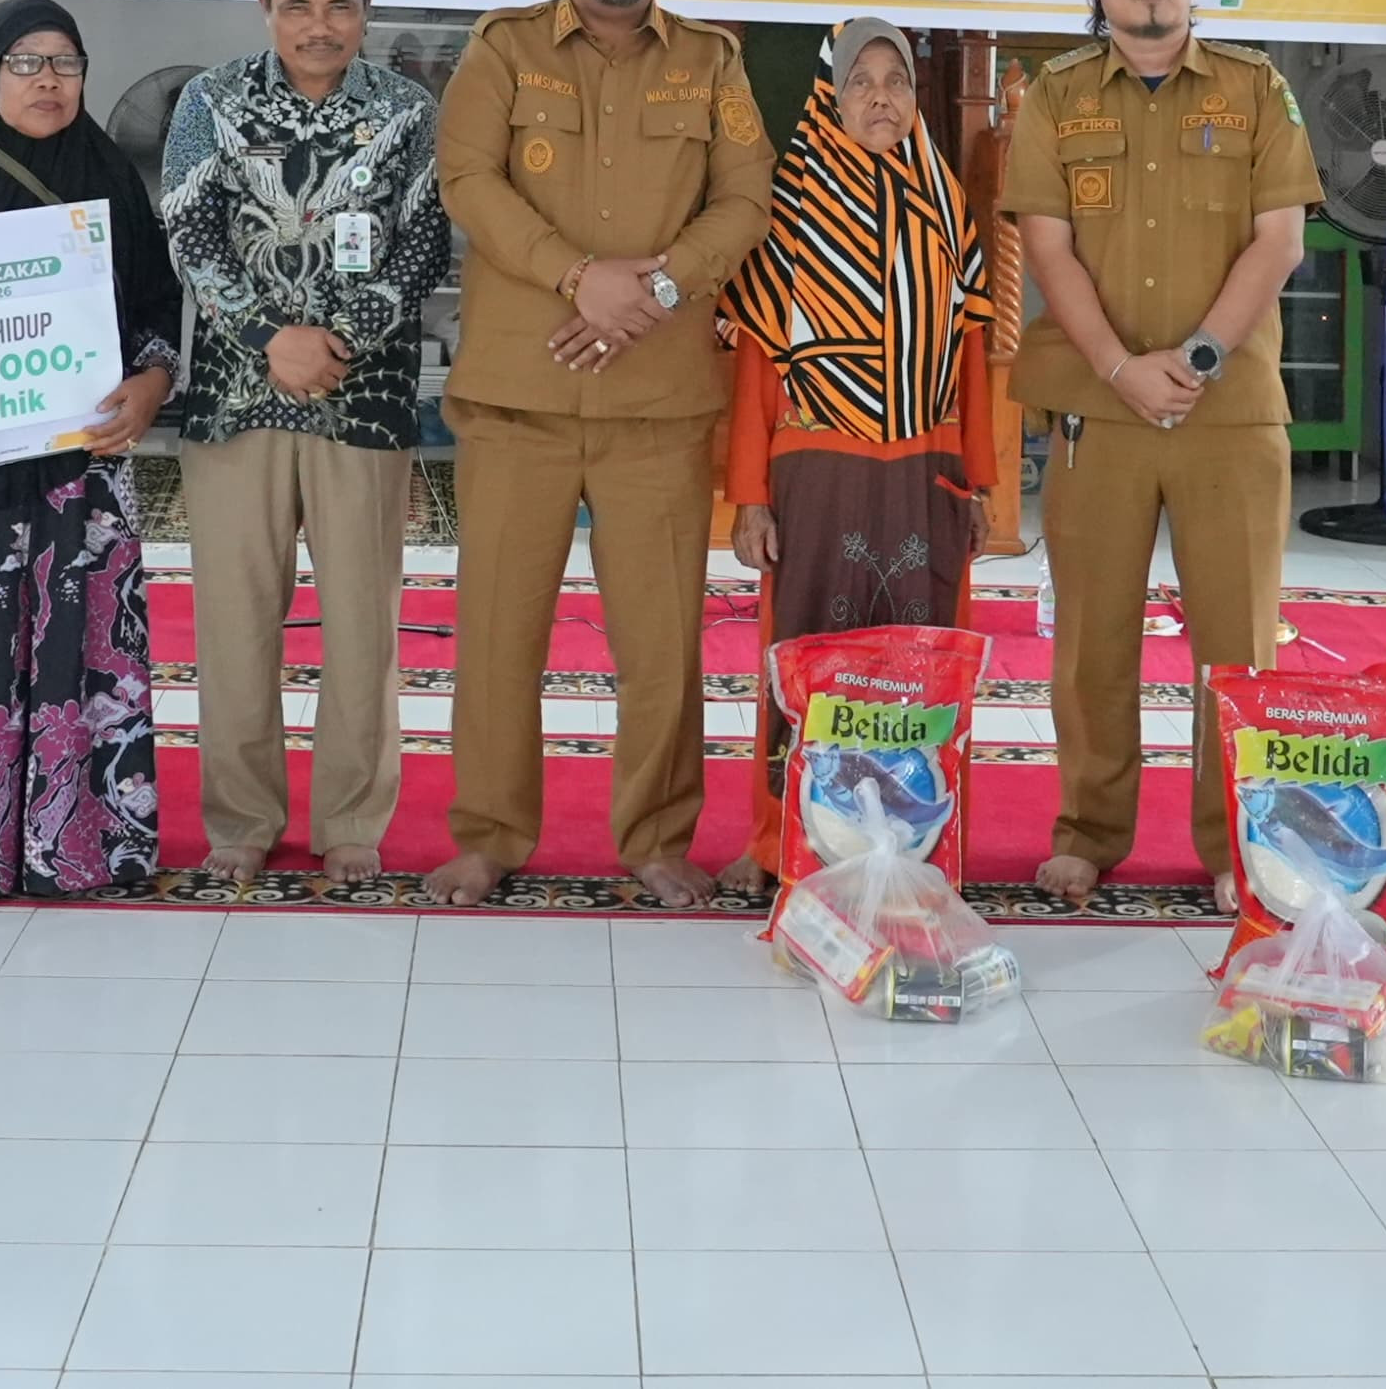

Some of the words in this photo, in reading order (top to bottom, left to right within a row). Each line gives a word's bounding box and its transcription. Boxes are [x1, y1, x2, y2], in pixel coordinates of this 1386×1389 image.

[517, 73, 579, 99] SYAMSURIZAL
[646, 89, 676, 104] WAKIL
[1187, 117, 1242, 128] CAMAT
[834, 672, 869, 689] BERAS
[869, 677, 924, 694] PREMIUM
[830, 704, 926, 742] Belida
[1265, 707, 1305, 721] BERAS
[1307, 709, 1367, 725] PREMIUM
[1266, 739, 1370, 777] Belida
